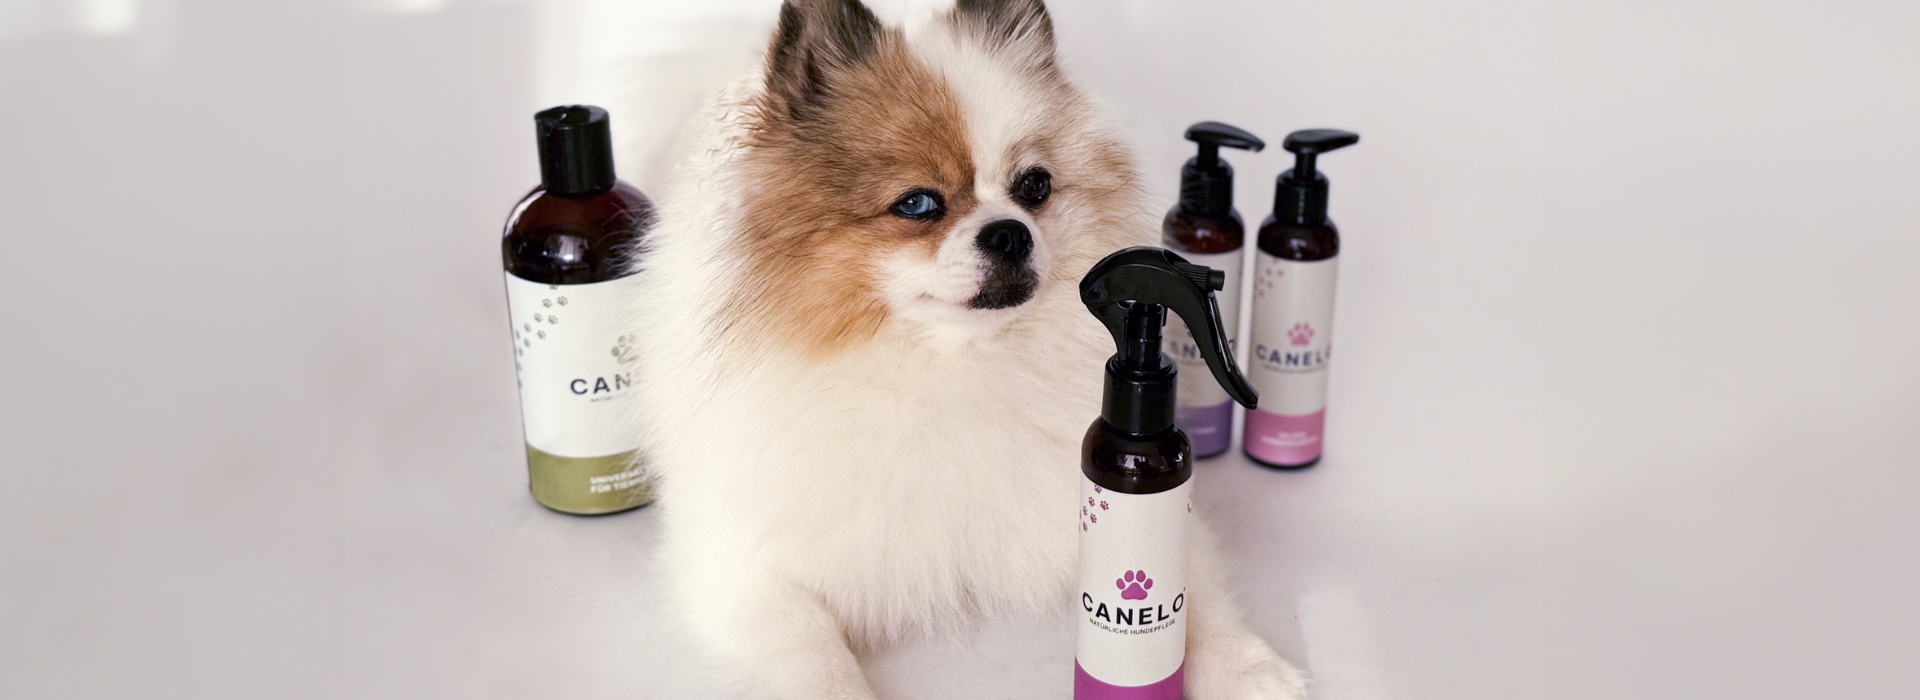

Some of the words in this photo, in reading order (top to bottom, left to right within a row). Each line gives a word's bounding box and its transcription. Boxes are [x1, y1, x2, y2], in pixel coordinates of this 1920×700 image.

[570, 371, 641, 395] CAN
[1082, 591, 1184, 626] CANELO
[1089, 617, 1128, 635] NATÜRLICHE
[1130, 617, 1176, 635] HUNDEPFLEGE
